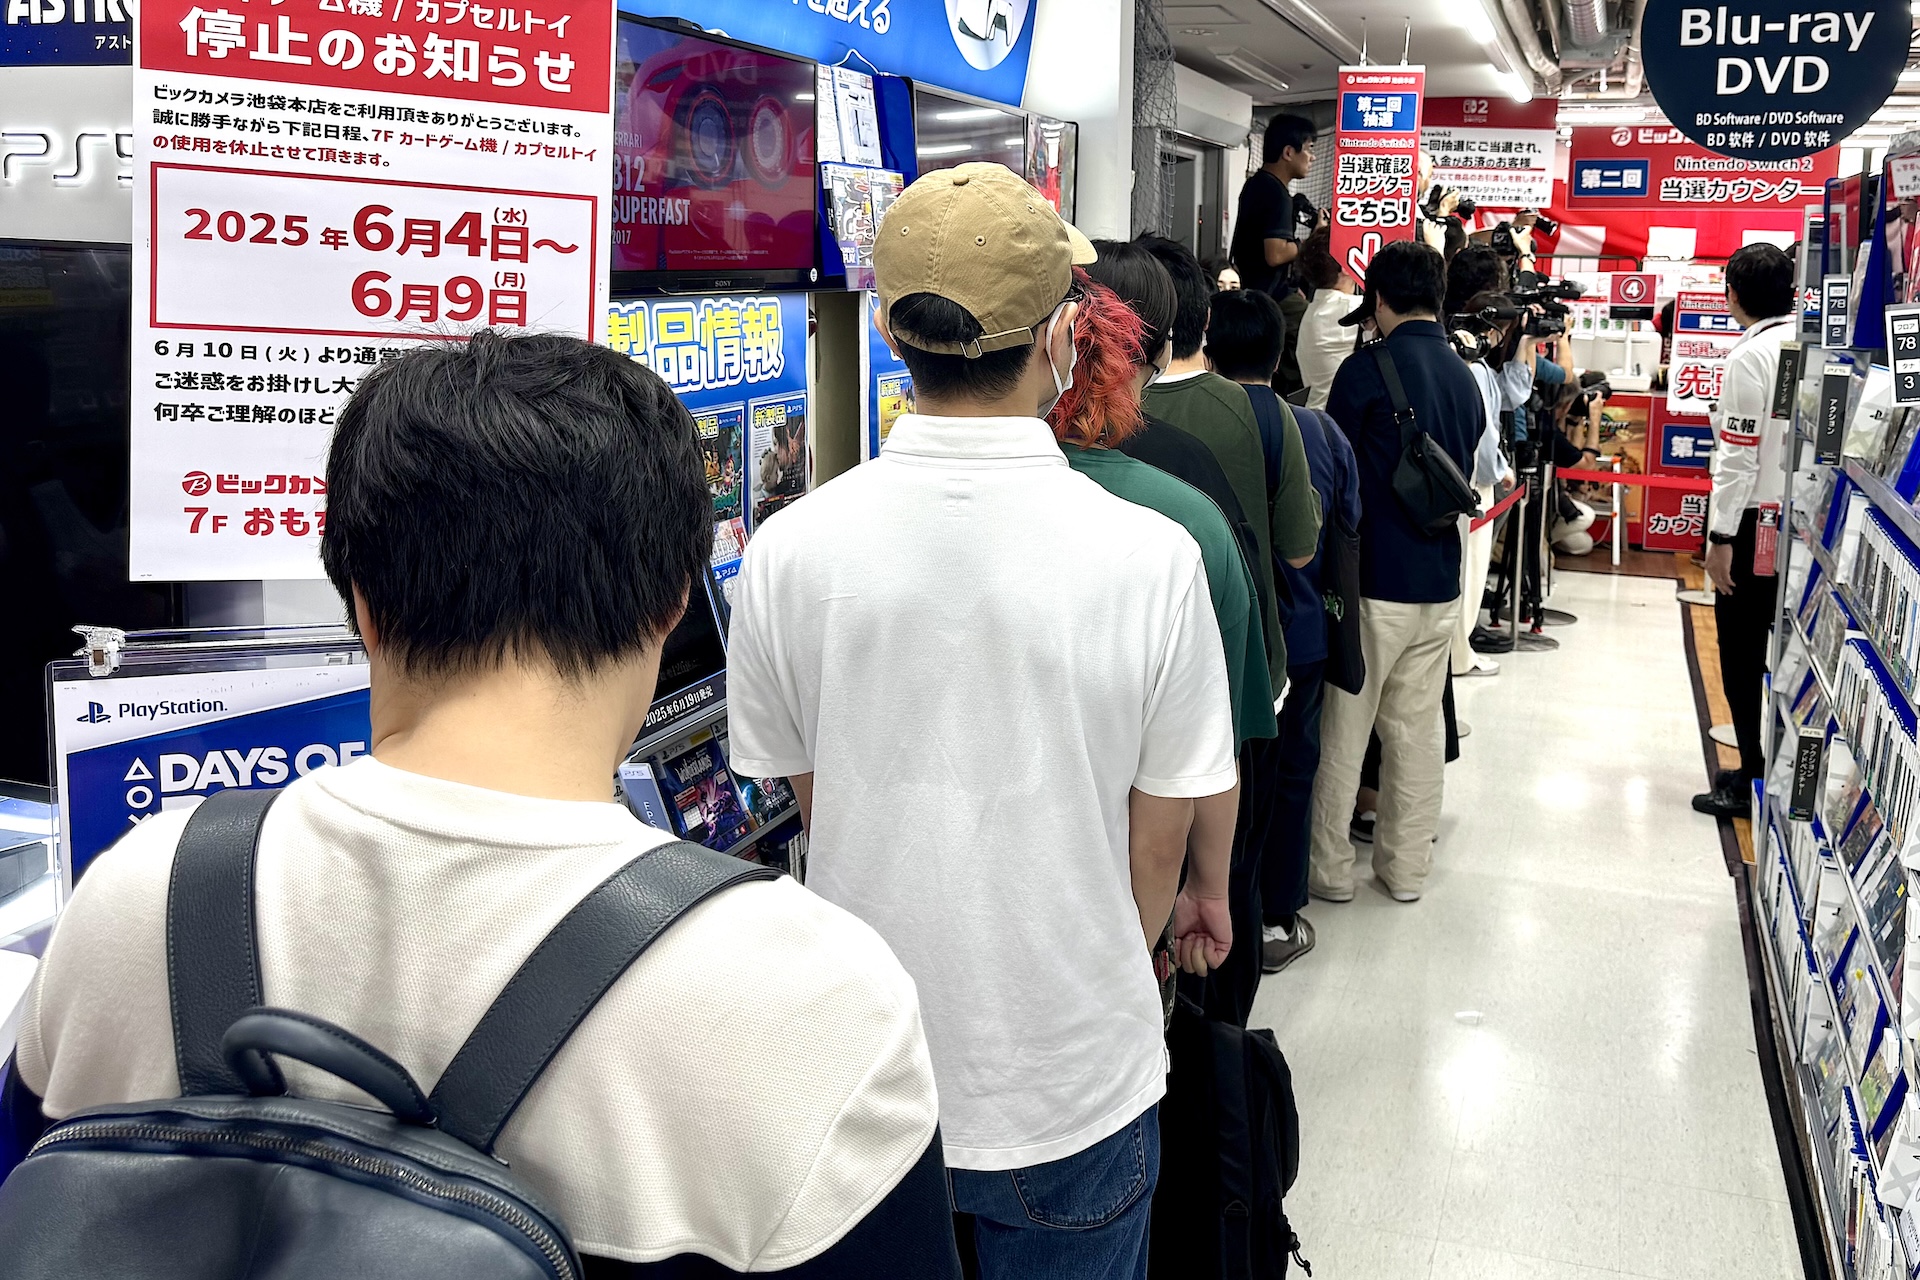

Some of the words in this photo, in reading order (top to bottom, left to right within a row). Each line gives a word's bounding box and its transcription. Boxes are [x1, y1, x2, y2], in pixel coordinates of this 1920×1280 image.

[7, 0, 133, 25] ASTR
[415, 0, 572, 38] カプセルトイ
[1679, 6, 1876, 52] Blu-ray
[179, 6, 575, 93] 停止のお知らせ
[1716, 55, 1829, 95] DVD
[153, 85, 581, 138] ビックカメラ池袋本店をご利用頂きありがとうございます。
[1357, 96, 1402, 112] 第二回
[1696, 113, 1712, 126] BD
[1713, 112, 1761, 126] Software
[1769, 112, 1794, 125] DVD
[1795, 111, 1845, 124] Software
[615, 132, 643, 149] ERRARI
[1340, 139, 1378, 147] Nintendo
[1379, 139, 1407, 147] Switch
[1637, 128, 1695, 144] ビック
[1706, 134, 1725, 147] BD
[1729, 131, 1755, 148] 软件
[1771, 132, 1801, 146] DVD
[1803, 130, 1831, 148] 软件
[153, 134, 390, 167] の使用を休止させて頂きます。
[514, 142, 597, 162] カプセルトイ
[1340, 155, 1411, 175] 当選確認
[1675, 158, 1745, 171] Nintendo
[1803, 159, 1812, 171] 2
[1581, 169, 1642, 188] 第二回
[1661, 178, 1824, 201] 当選カウンター
[612, 195, 690, 225] SUPERFAST
[1339, 200, 1409, 225] こちら!
[1626, 281, 1641, 296] 4
[1830, 299, 1846, 309] 78
[1831, 327, 1841, 337] 2
[1896, 323, 1915, 332] フロア
[1896, 336, 1917, 351] 78
[154, 371, 361, 395] ご迷惑をお掛けし大
[1903, 375, 1915, 390] 3
[153, 402, 335, 426] 何卒ご理解のほど
[754, 404, 787, 428] 新製品
[1826, 398, 1839, 436] アクション
[695, 415, 719, 440] 製品
[1726, 416, 1756, 434] 広報
[183, 507, 228, 534] 7F
[160, 746, 289, 793] DAYS
